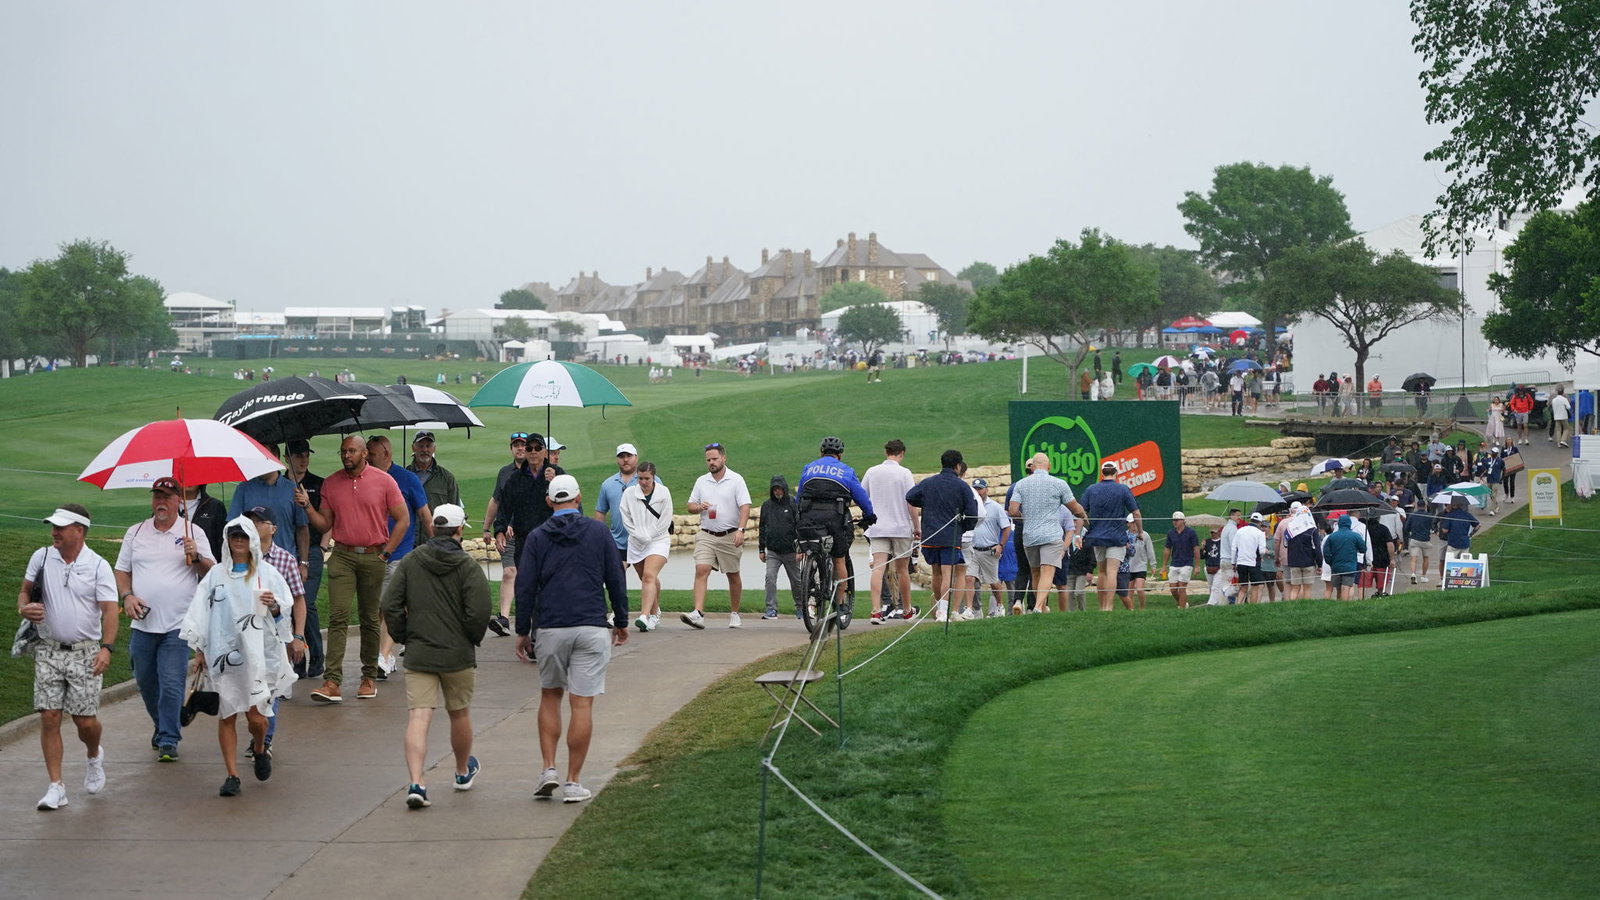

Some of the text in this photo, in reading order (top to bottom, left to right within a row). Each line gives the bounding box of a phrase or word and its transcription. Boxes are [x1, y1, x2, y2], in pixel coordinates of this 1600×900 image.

[217, 392, 306, 425] TaylorMade
[805, 465, 844, 478] POLICE
[1029, 442, 1095, 485] bigo
[1115, 457, 1138, 475] Live
